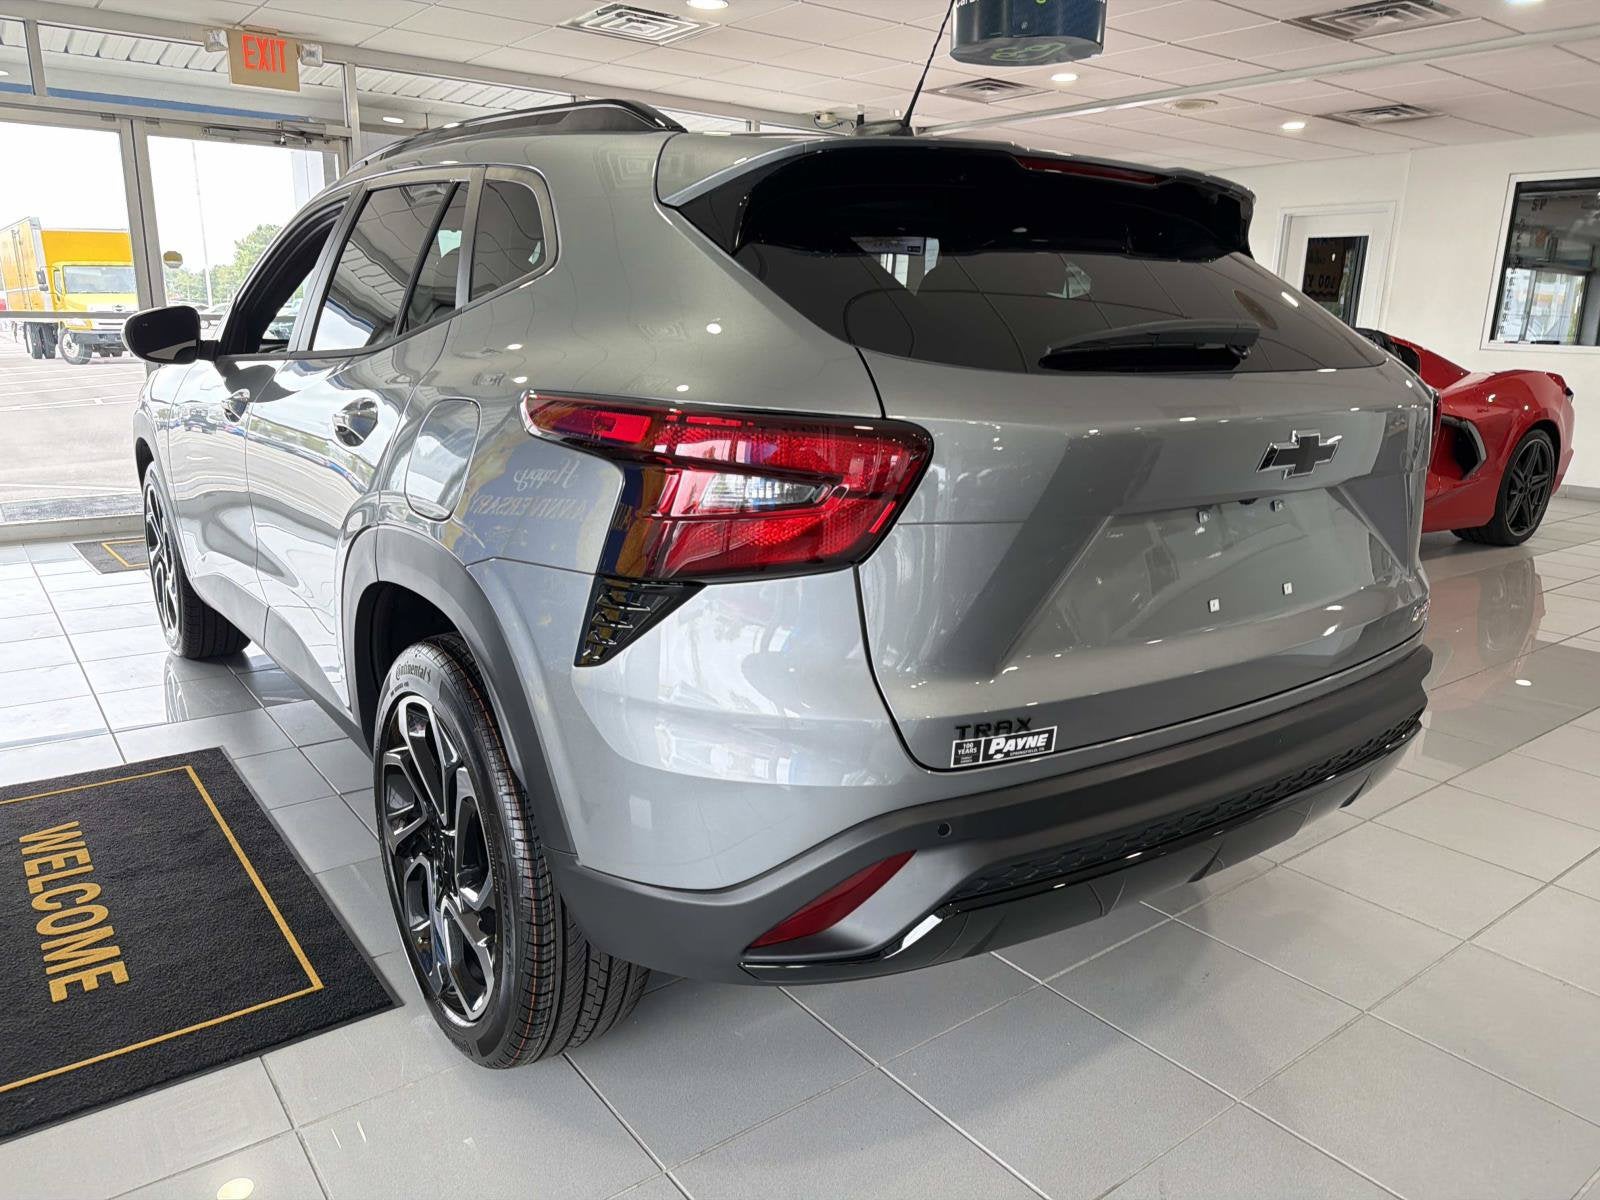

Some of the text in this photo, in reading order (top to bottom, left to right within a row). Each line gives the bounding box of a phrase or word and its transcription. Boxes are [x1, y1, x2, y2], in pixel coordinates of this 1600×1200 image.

[242, 33, 287, 74] EXIT
[395, 660, 427, 681] Continental
[955, 717, 1031, 740] TRAX
[958, 747, 977, 755] YEARS
[988, 733, 1049, 755] PAYNE
[19, 820, 129, 1003] WELCOME
